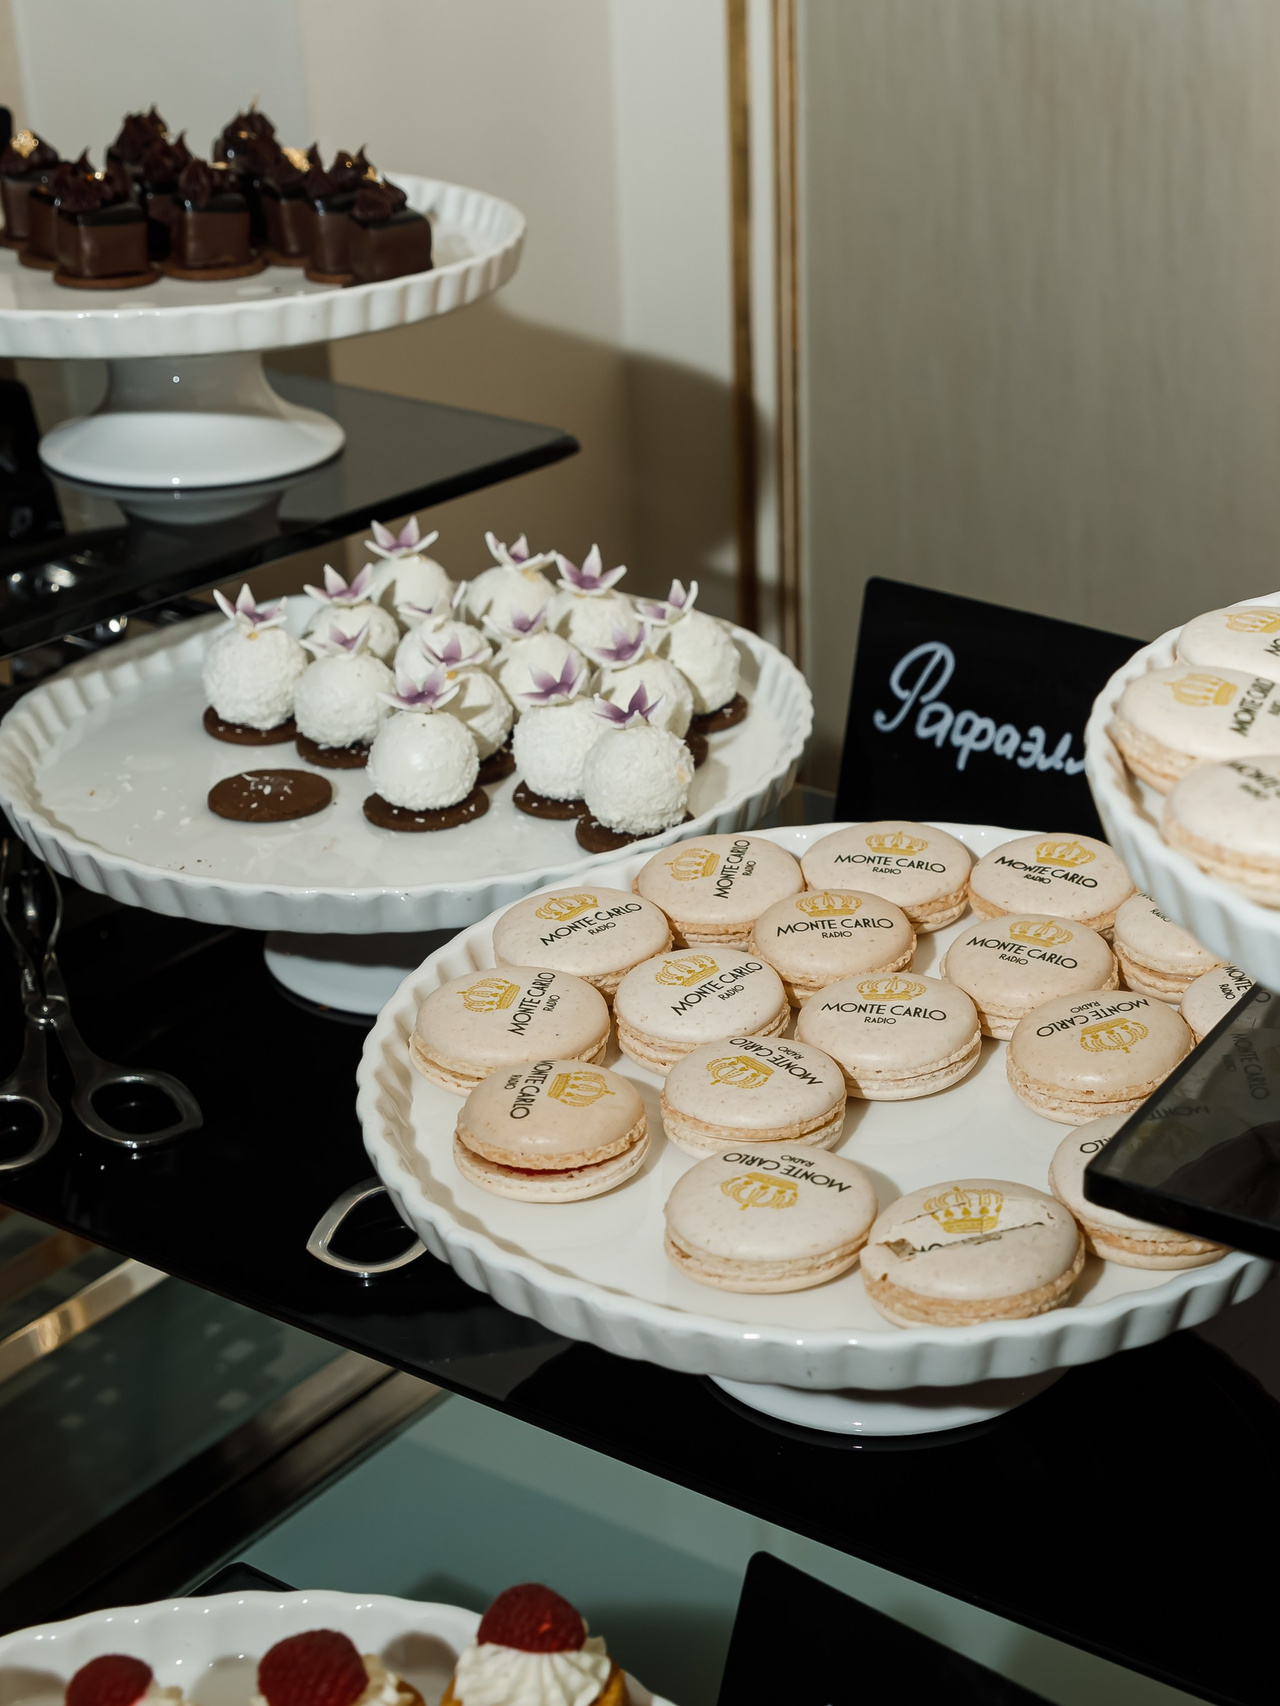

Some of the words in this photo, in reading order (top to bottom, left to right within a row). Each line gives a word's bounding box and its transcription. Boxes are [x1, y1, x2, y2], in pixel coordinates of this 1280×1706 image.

[874, 641, 1086, 776] Рафаэл
[713, 866, 738, 899] MONTE
[726, 839, 750, 864] CARLO
[742, 860, 756, 877] RADIO
[834, 854, 892, 867] MONTE
[895, 857, 947, 874] CARLO
[872, 866, 902, 875] RADIO
[994, 856, 1051, 876] MONTE
[1050, 868, 1099, 889] CARLO
[1023, 873, 1052, 885] RADIO
[539, 916, 598, 947] MONTE
[594, 902, 643, 921] CARLO
[588, 921, 617, 936] RADIO
[776, 919, 838, 937] MONTE
[840, 917, 894, 930] CARLO
[821, 930, 853, 939] RADIO
[966, 936, 1025, 956] MONTE
[1026, 948, 1079, 970] CARLO
[998, 953, 1029, 966] RADIO
[1223, 965, 1252, 991] MONTE
[670, 981, 722, 1017] MONTE
[718, 962, 764, 985] CARLO
[717, 984, 745, 1002] RADIO
[1219, 983, 1236, 1000] RADIO
[507, 1000, 539, 1036] MONTE
[530, 971, 556, 1001] CARLO
[543, 994, 561, 1013] RADIO
[821, 1002, 887, 1015] MONTE
[890, 1004, 947, 1022] CARLO
[1070, 1001, 1101, 1014] RADIO
[1081, 998, 1150, 1025] MONTE
[864, 1016, 897, 1025] RADIO
[1036, 1015, 1084, 1038] CARLO
[729, 1037, 774, 1058] CARLO
[777, 1046, 804, 1060] RADIO
[1231, 1033, 1256, 1064] MONTE
[524, 1060, 557, 1084] MONTE
[767, 1055, 824, 1086] MONTE
[1241, 1063, 1270, 1100] CARLO
[510, 1085, 540, 1119] CARLO
[722, 1152, 782, 1172] CARLO
[780, 1154, 815, 1168] RADIO
[779, 1164, 852, 1193] MONTE
